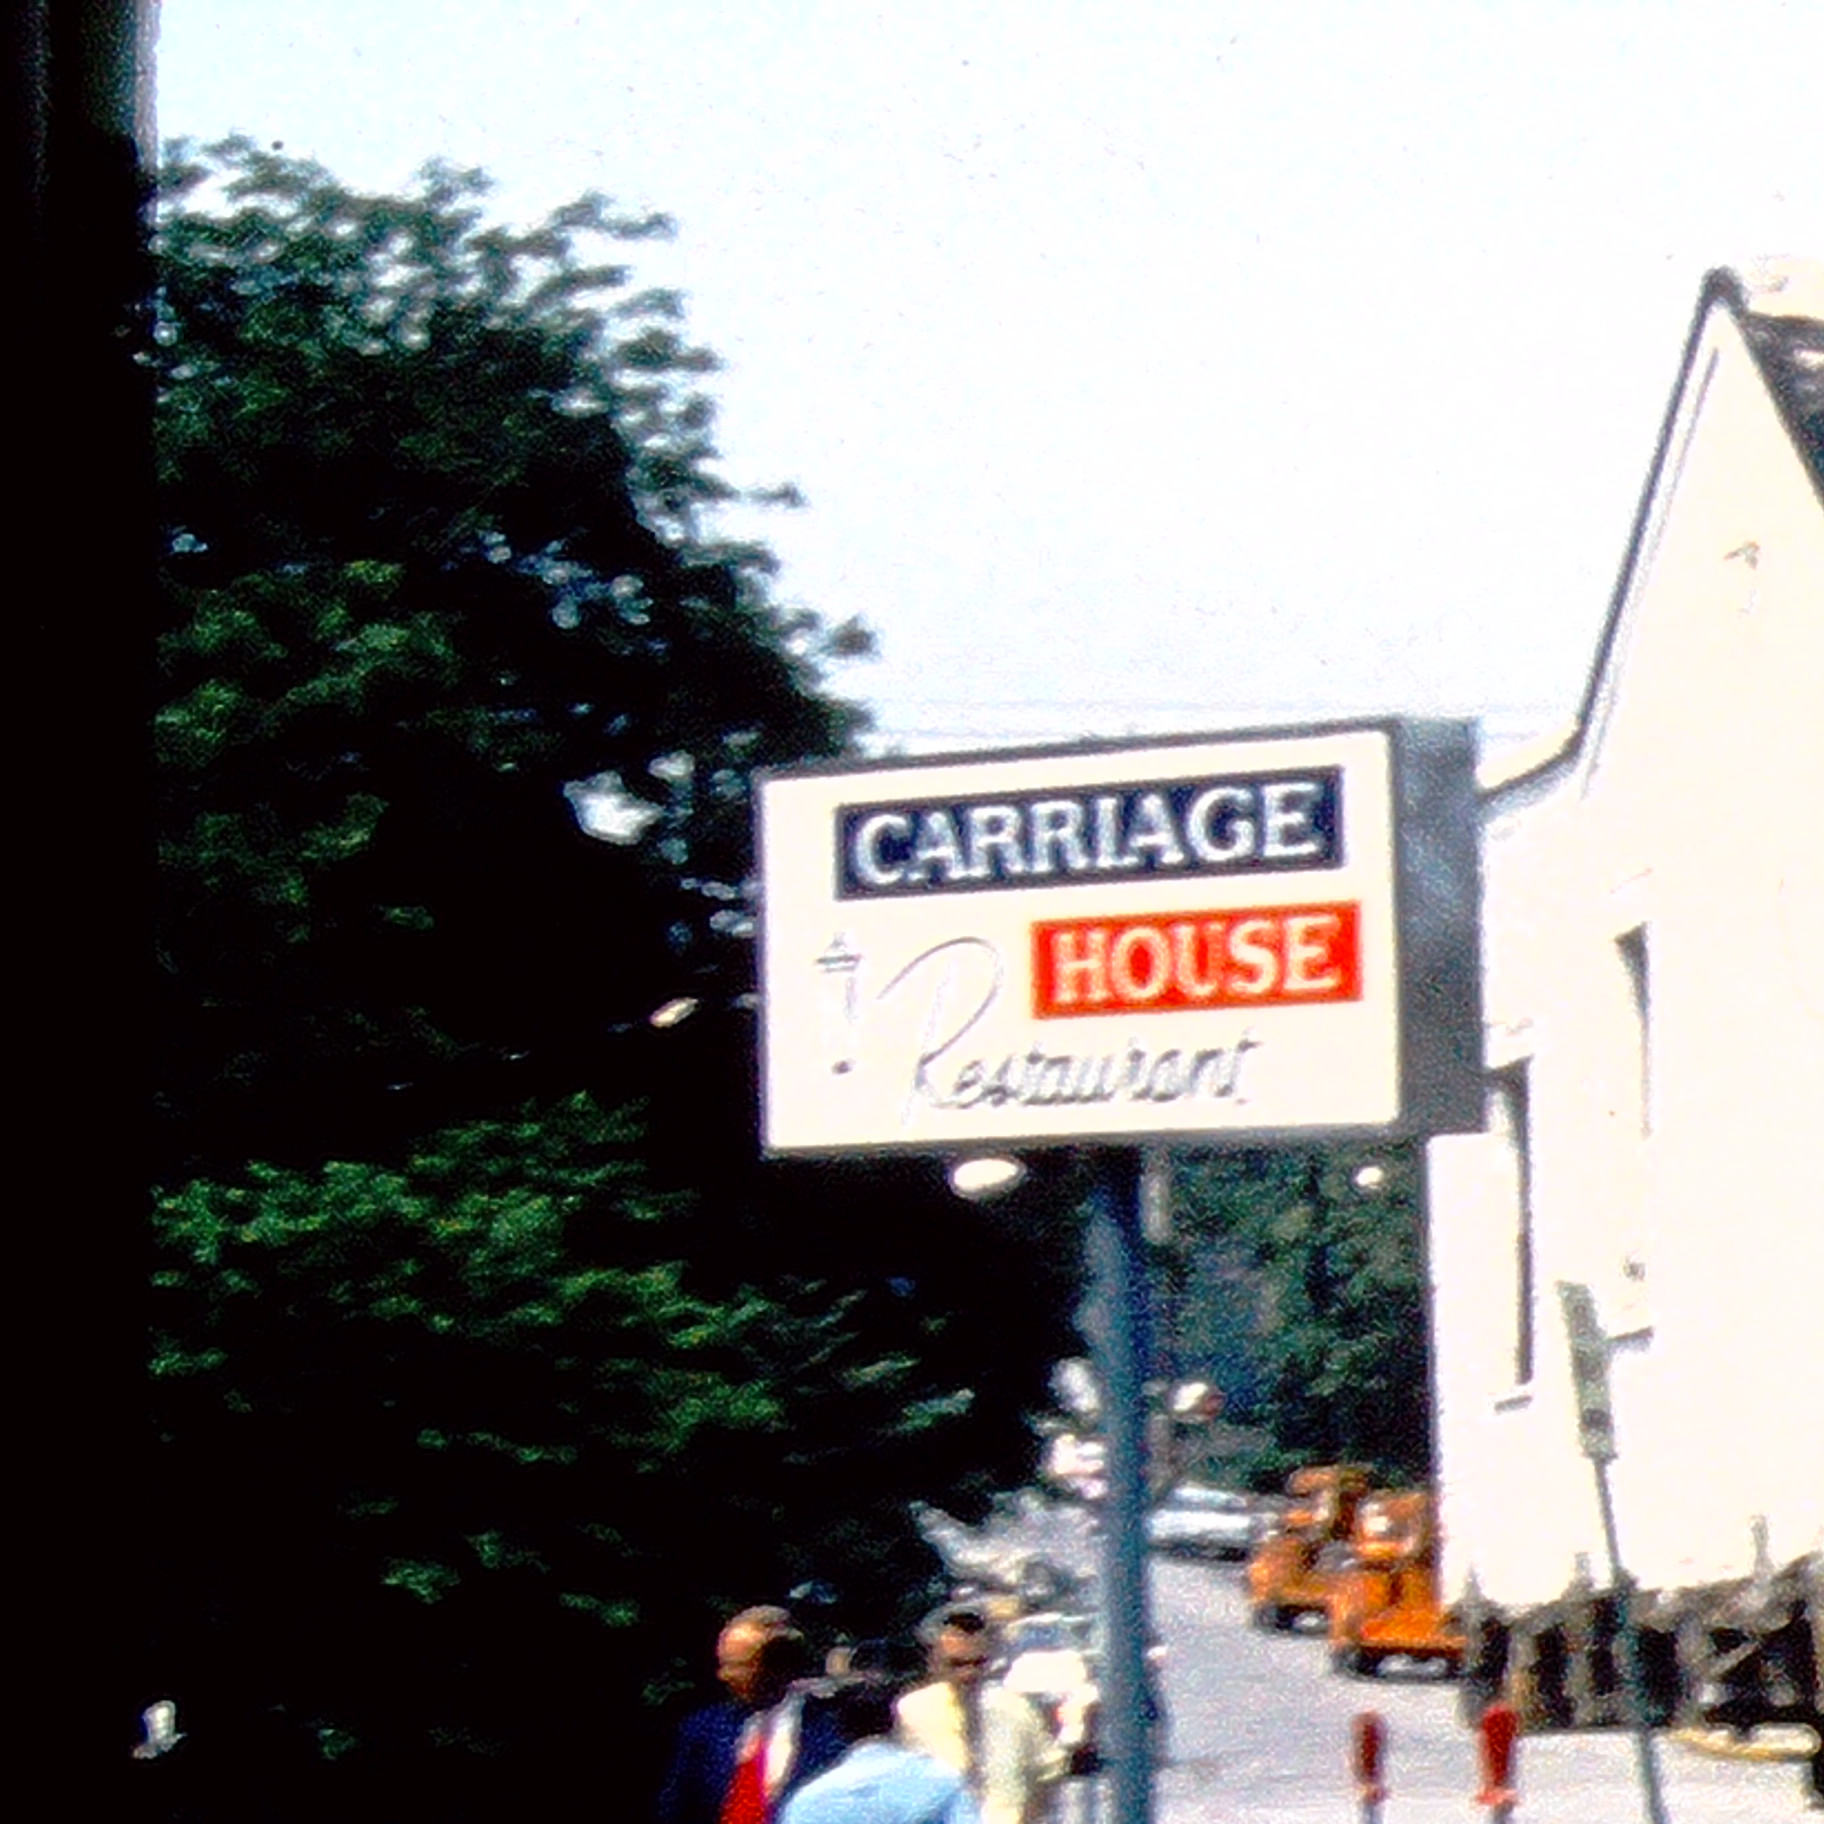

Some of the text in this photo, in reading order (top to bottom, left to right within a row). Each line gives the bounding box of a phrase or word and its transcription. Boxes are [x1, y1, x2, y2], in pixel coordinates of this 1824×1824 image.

[853, 780, 1324, 888] CARRIAGE
[1049, 912, 1342, 1004] HOUSE
[876, 935, 1262, 1127] Restaurant
